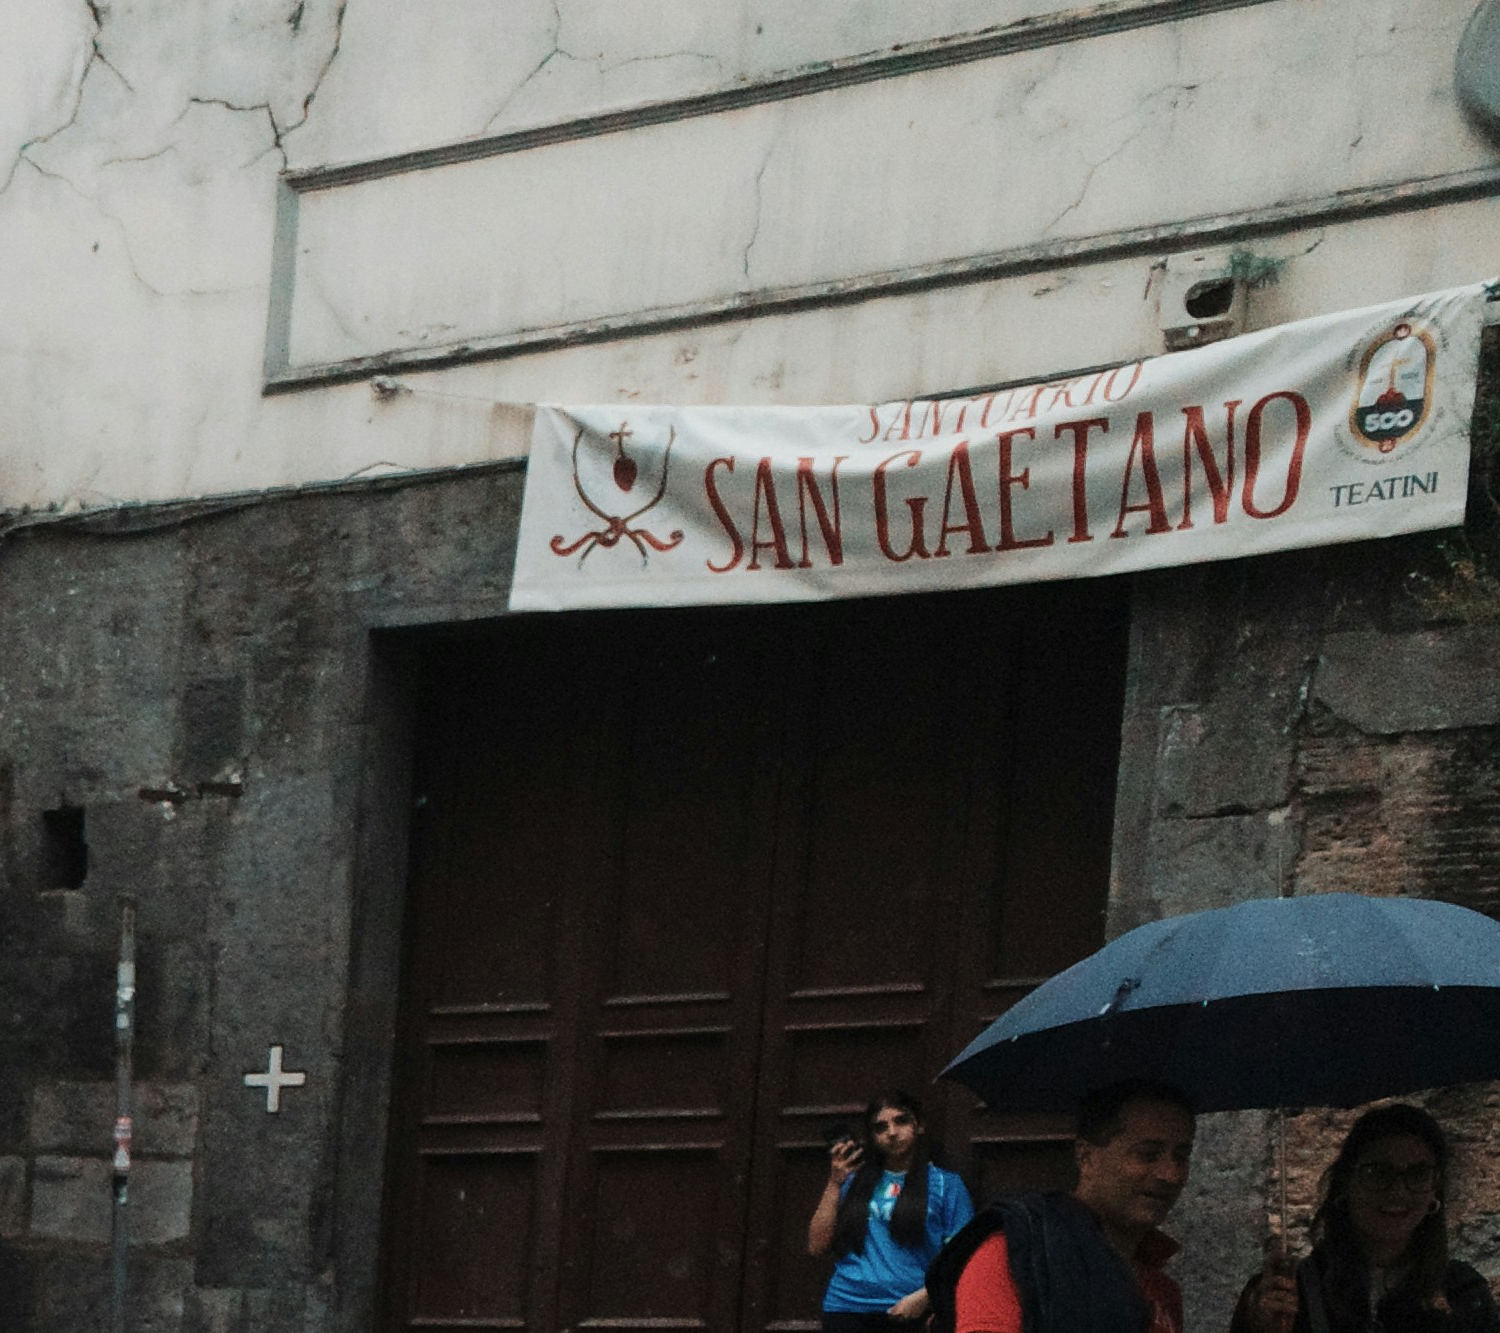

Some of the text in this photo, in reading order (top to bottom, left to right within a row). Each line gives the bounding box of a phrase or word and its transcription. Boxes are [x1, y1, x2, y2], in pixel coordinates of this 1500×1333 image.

[705, 455, 845, 573] SAN
[872, 389, 1312, 563] GAETANO
[1329, 471, 1439, 508] TEATINI
